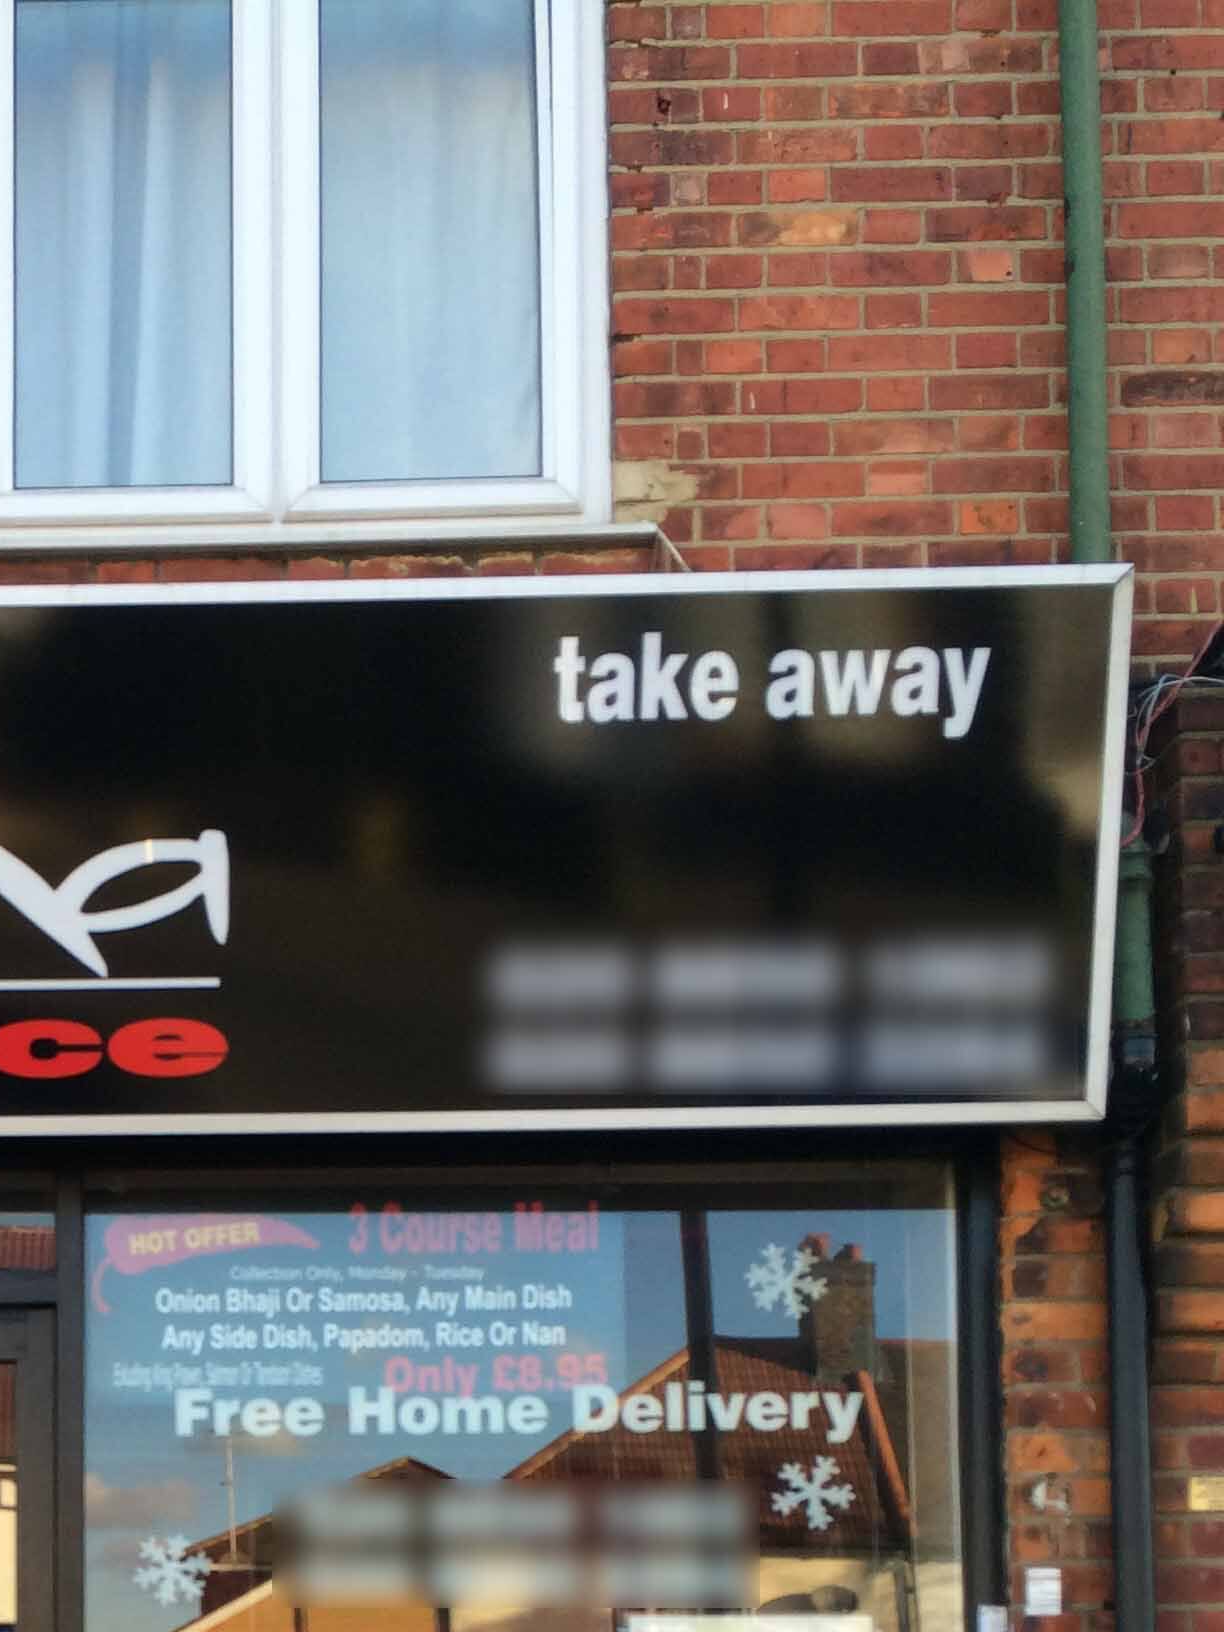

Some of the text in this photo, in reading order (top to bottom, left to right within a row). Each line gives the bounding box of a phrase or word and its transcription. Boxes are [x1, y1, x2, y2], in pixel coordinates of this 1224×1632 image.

[554, 631, 992, 740] take away
[129, 1221, 260, 1256] HOT OFFER
[348, 1200, 599, 1254] 3 Course Meal
[155, 1283, 573, 1318] Onion Bhaji Or Samosa, Any Main Dish
[161, 1321, 567, 1355] Any Side Dish, Papadom, Rice Or Nan
[384, 1352, 609, 1397] Only £8.95
[176, 1380, 864, 1444] Free Home Delivery
